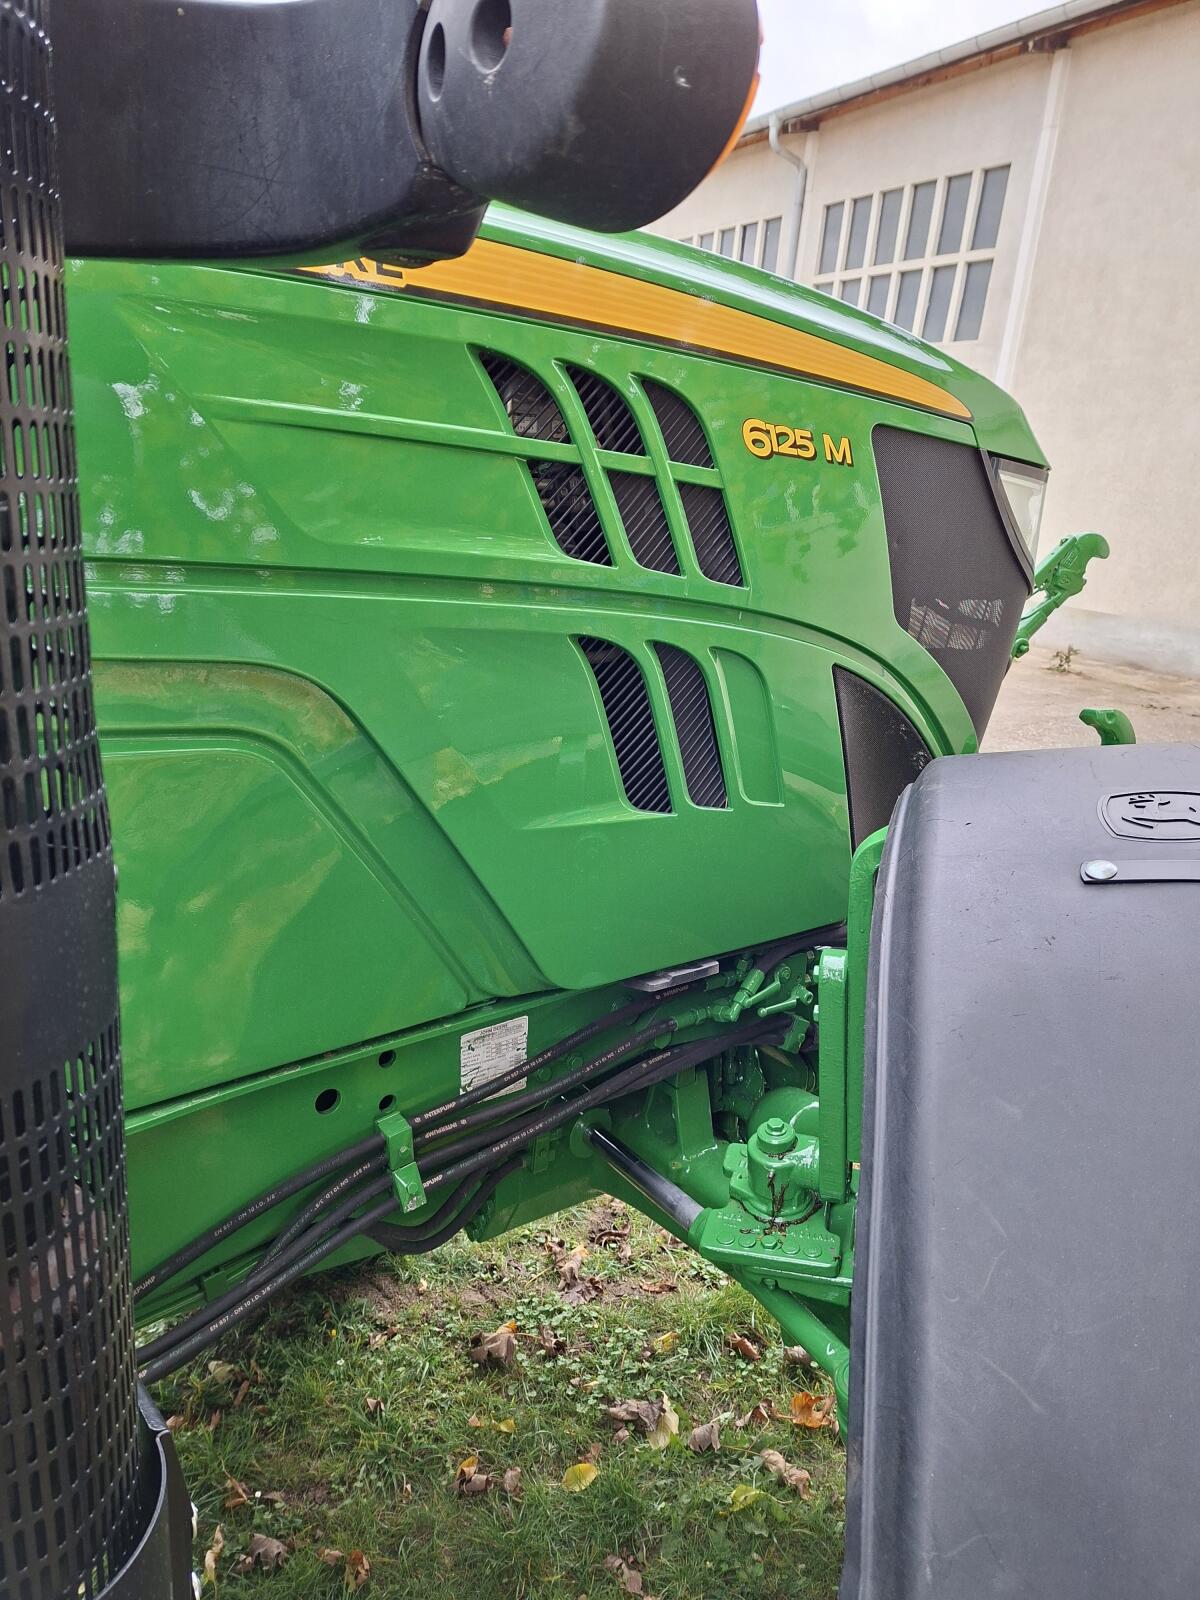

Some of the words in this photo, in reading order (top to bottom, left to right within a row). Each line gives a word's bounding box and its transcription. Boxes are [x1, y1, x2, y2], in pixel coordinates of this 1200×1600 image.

[742, 418, 817, 460] 6125
[822, 432, 853, 467] M
[423, 1101, 457, 1119] INTERPUMP
[424, 1121, 458, 1139] INTERPUMP
